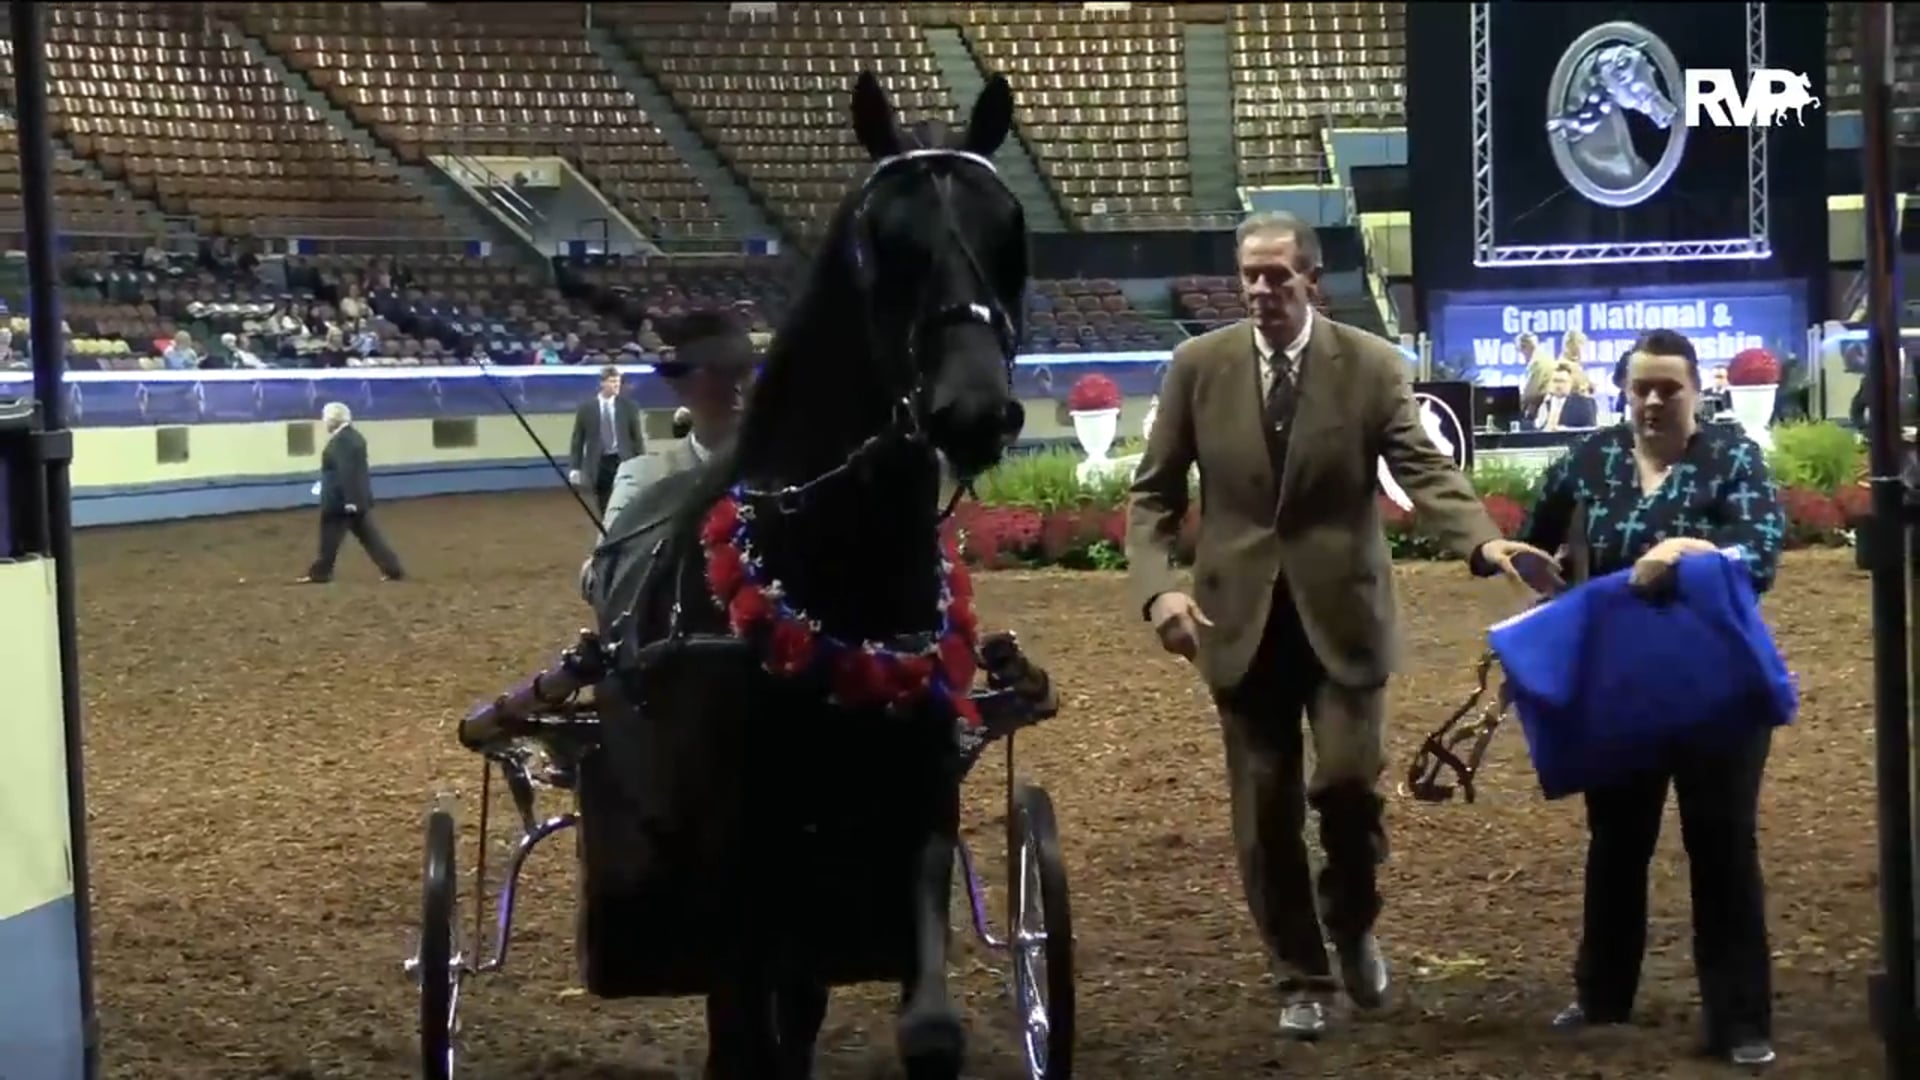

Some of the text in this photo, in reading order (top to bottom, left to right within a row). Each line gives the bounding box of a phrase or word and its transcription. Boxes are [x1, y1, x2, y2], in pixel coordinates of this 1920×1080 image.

[1502, 300, 1733, 333] Grand National &
[1473, 337, 1556, 365] Wod
